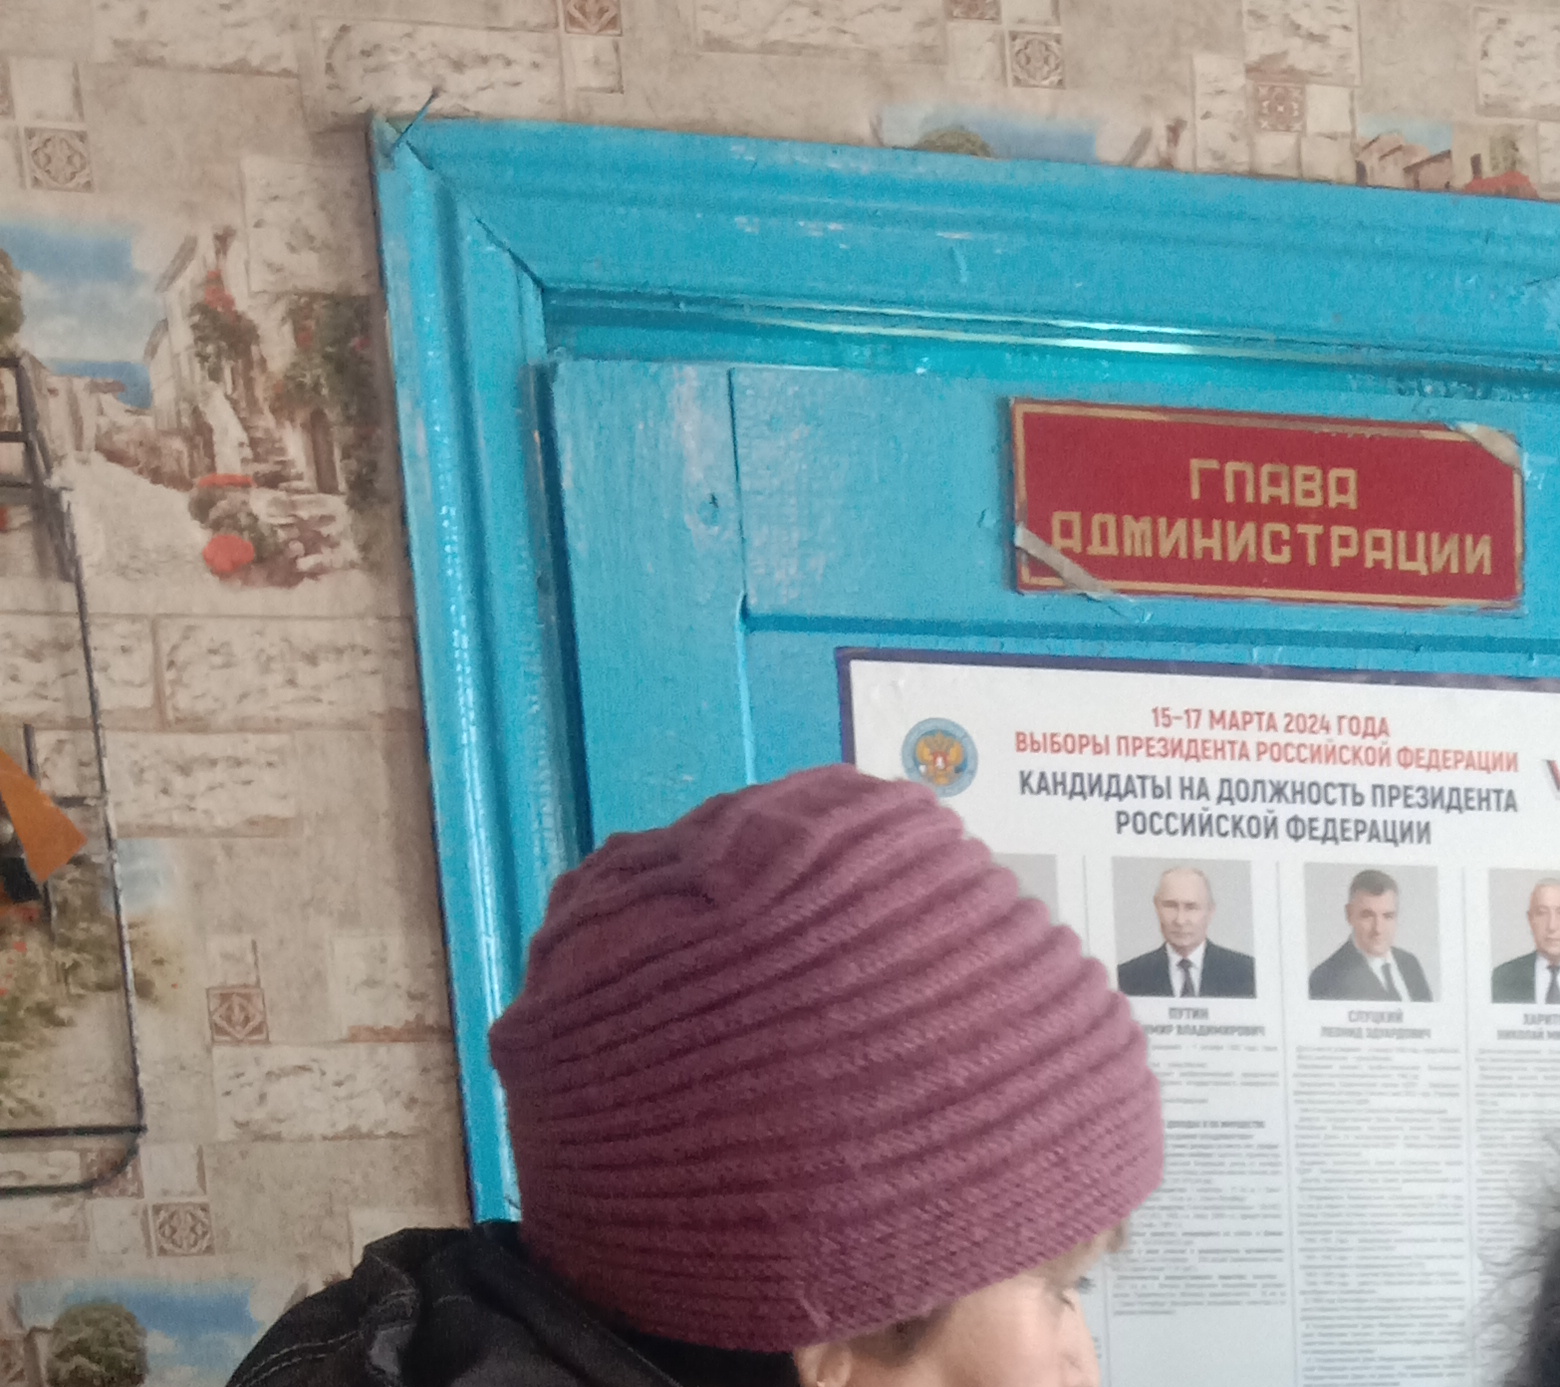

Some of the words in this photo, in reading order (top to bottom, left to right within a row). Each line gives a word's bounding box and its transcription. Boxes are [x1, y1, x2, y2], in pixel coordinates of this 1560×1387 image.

[1190, 457, 1358, 509] ГЛАВА
[1051, 510, 1494, 575] АДМИНИСТРАЦИИ
[1151, 706, 1202, 730] 15-17
[1209, 708, 1278, 733] МАРТА
[1284, 712, 1332, 735] 2024
[1337, 714, 1391, 740] ГОДА
[1014, 730, 1110, 756] ВЫБОРЫ
[1116, 735, 1251, 763] ПРЕЗИДЕНТА
[1256, 737, 1392, 768] РОССИЙСКОЙ
[1397, 745, 1519, 774] ФЕДЕРАЦИИ
[1019, 769, 1172, 802] КАНДИДАТЫ
[1179, 775, 1210, 802] НА
[1215, 777, 1366, 808] ДОЛЖНОСТЬ
[1371, 783, 1518, 815] ПРЕЗИДЕНТА
[1115, 806, 1279, 841] РОССИЙСКОЙ
[1285, 814, 1432, 847] ФЕДЕРАЦИИ
